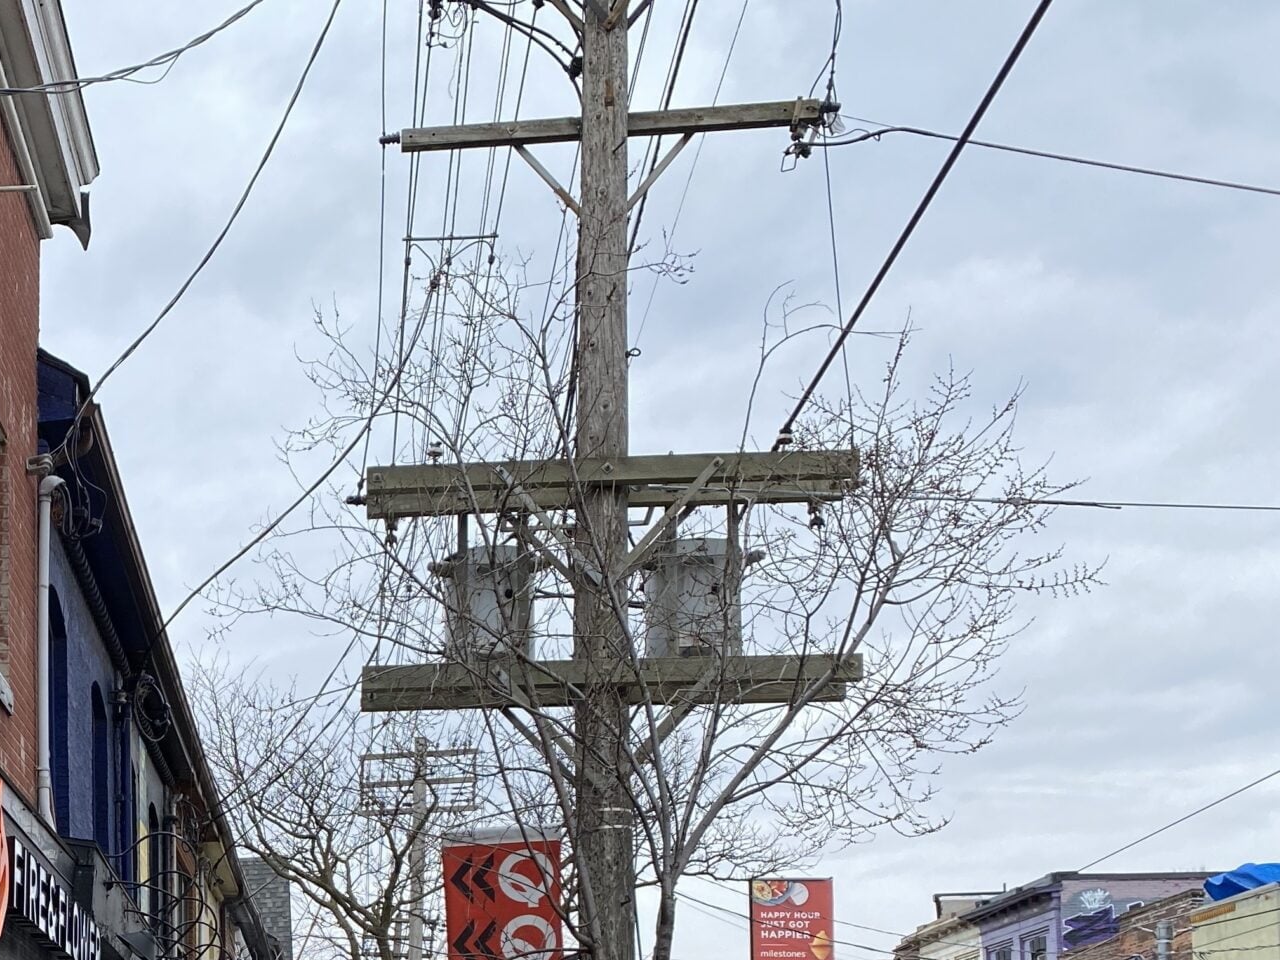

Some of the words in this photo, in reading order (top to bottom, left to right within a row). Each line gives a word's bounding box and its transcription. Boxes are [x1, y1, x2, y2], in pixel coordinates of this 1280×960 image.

[498, 849, 554, 908] Q
[760, 911, 791, 919] HAPPY
[794, 911, 821, 919] HOUR
[760, 920, 786, 928] JUST
[789, 920, 810, 928] GOT
[761, 930, 811, 939] HAPPIER
[760, 950, 806, 958] milestones
